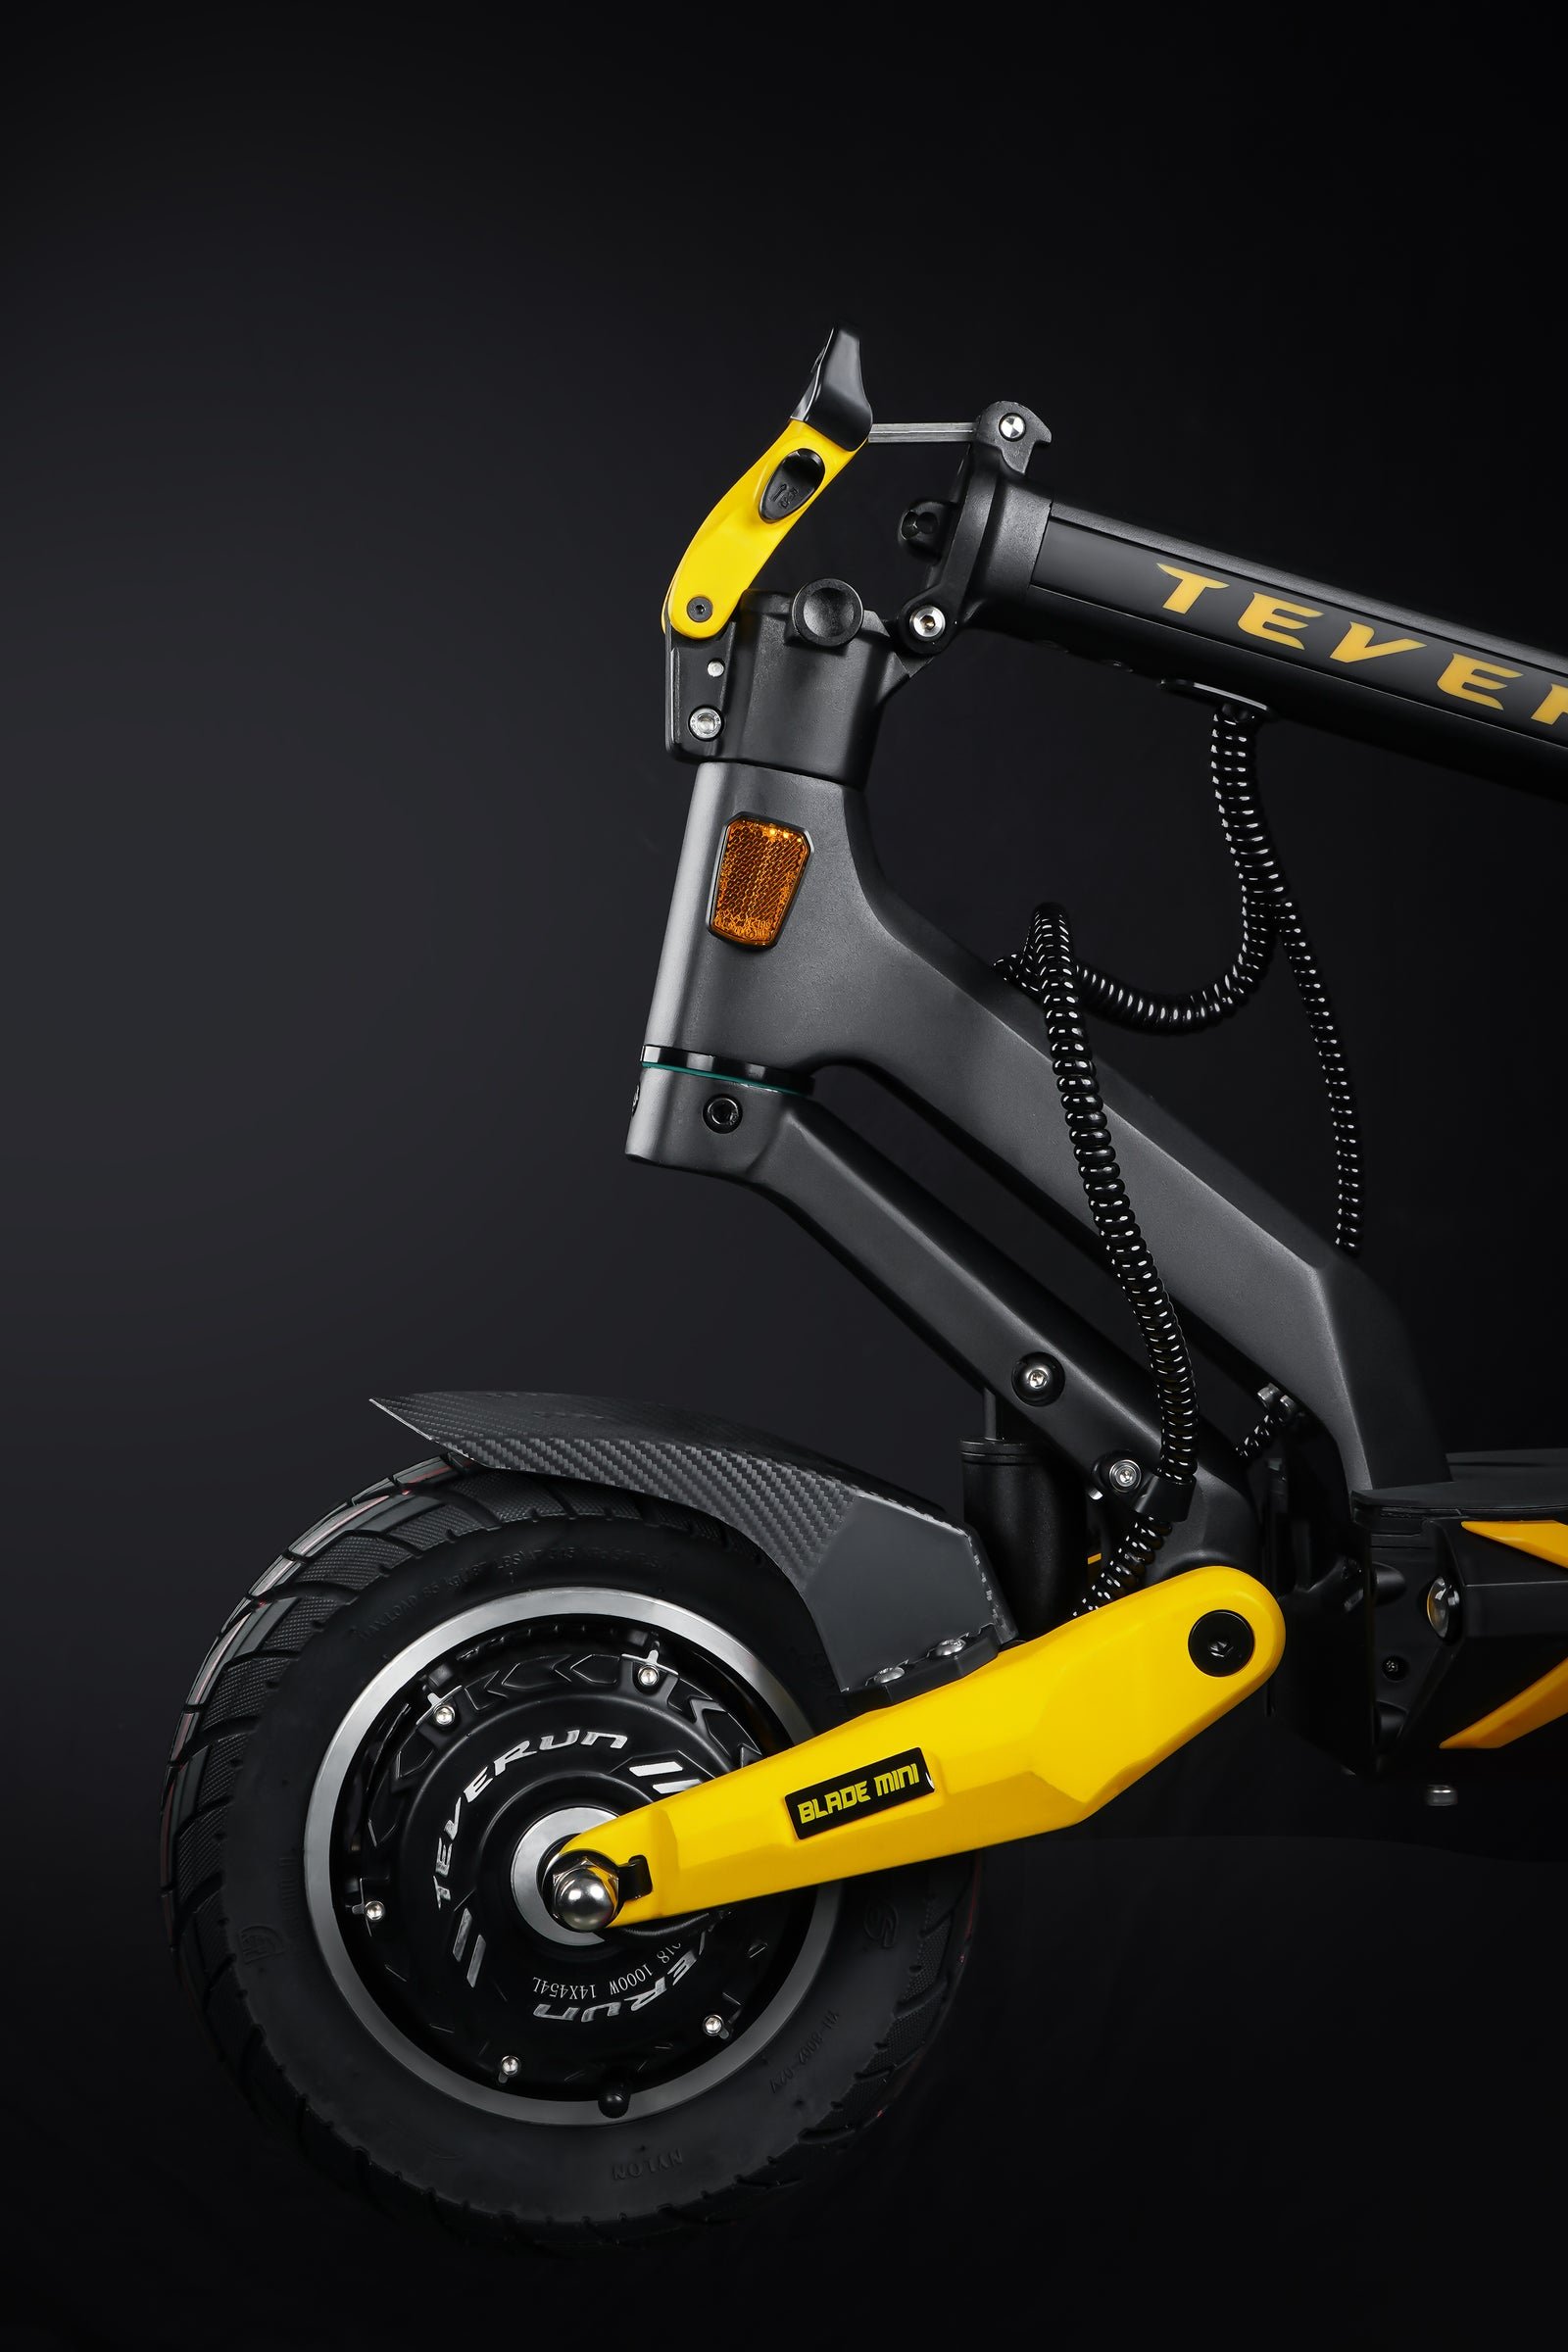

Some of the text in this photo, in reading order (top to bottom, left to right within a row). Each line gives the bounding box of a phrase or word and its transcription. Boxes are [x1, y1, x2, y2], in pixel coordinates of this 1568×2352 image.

[796, 1762, 920, 1825] BLADE MINI
[532, 1933, 706, 2023] ERUN
[532, 1976, 597, 2001] 14X454L
[609, 1963, 654, 1996] 1000W
